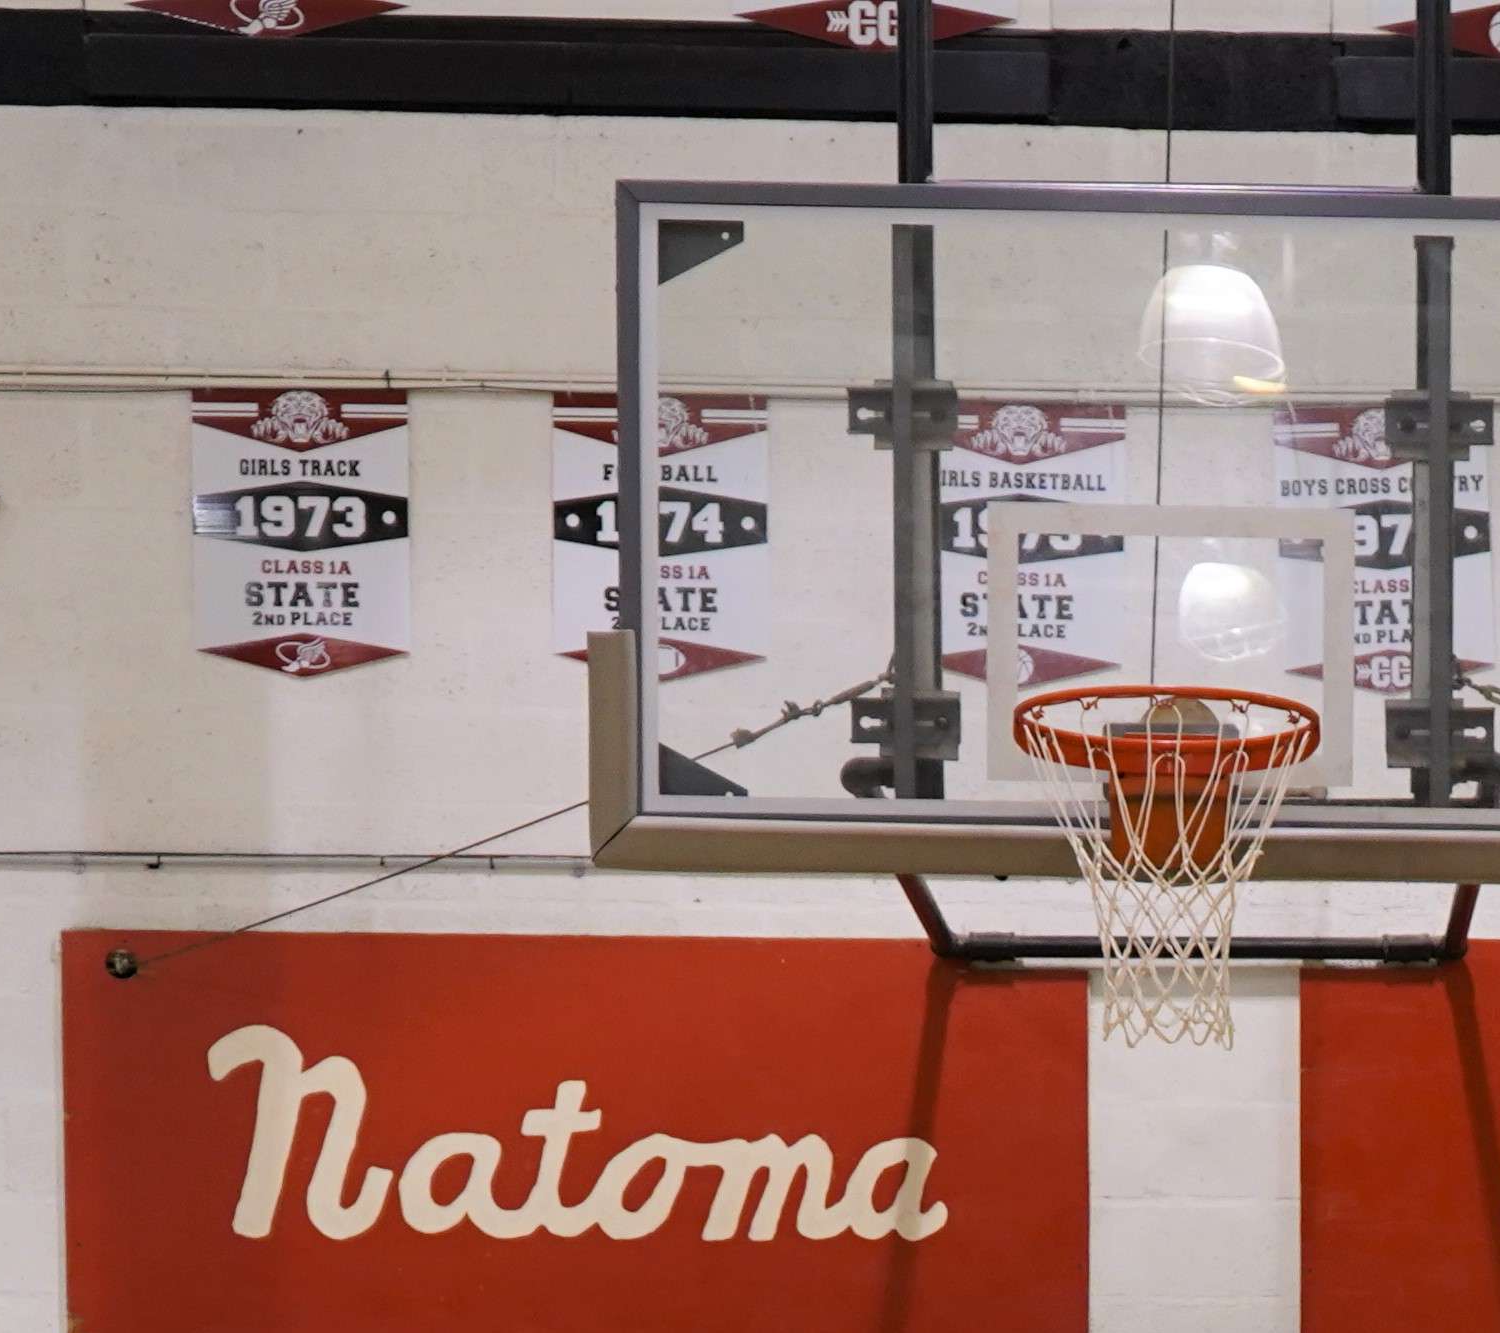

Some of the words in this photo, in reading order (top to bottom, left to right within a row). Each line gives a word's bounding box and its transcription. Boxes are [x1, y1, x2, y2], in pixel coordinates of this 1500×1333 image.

[239, 459, 292, 477] GIRLS
[297, 459, 361, 477] TRACK
[988, 472, 1107, 492] BASKETBALL
[1280, 478, 1329, 497] BOYS
[1335, 477, 1391, 495] CROSS
[234, 496, 367, 539] 1973
[596, 501, 725, 544] 174
[261, 560, 325, 575] CLASS
[329, 560, 352, 576] 1A
[688, 566, 710, 580] 1A
[1044, 573, 1067, 588] 1A
[245, 582, 360, 608] STATE
[290, 612, 353, 626] PLACE
[206, 1024, 948, 1242] Natoma
